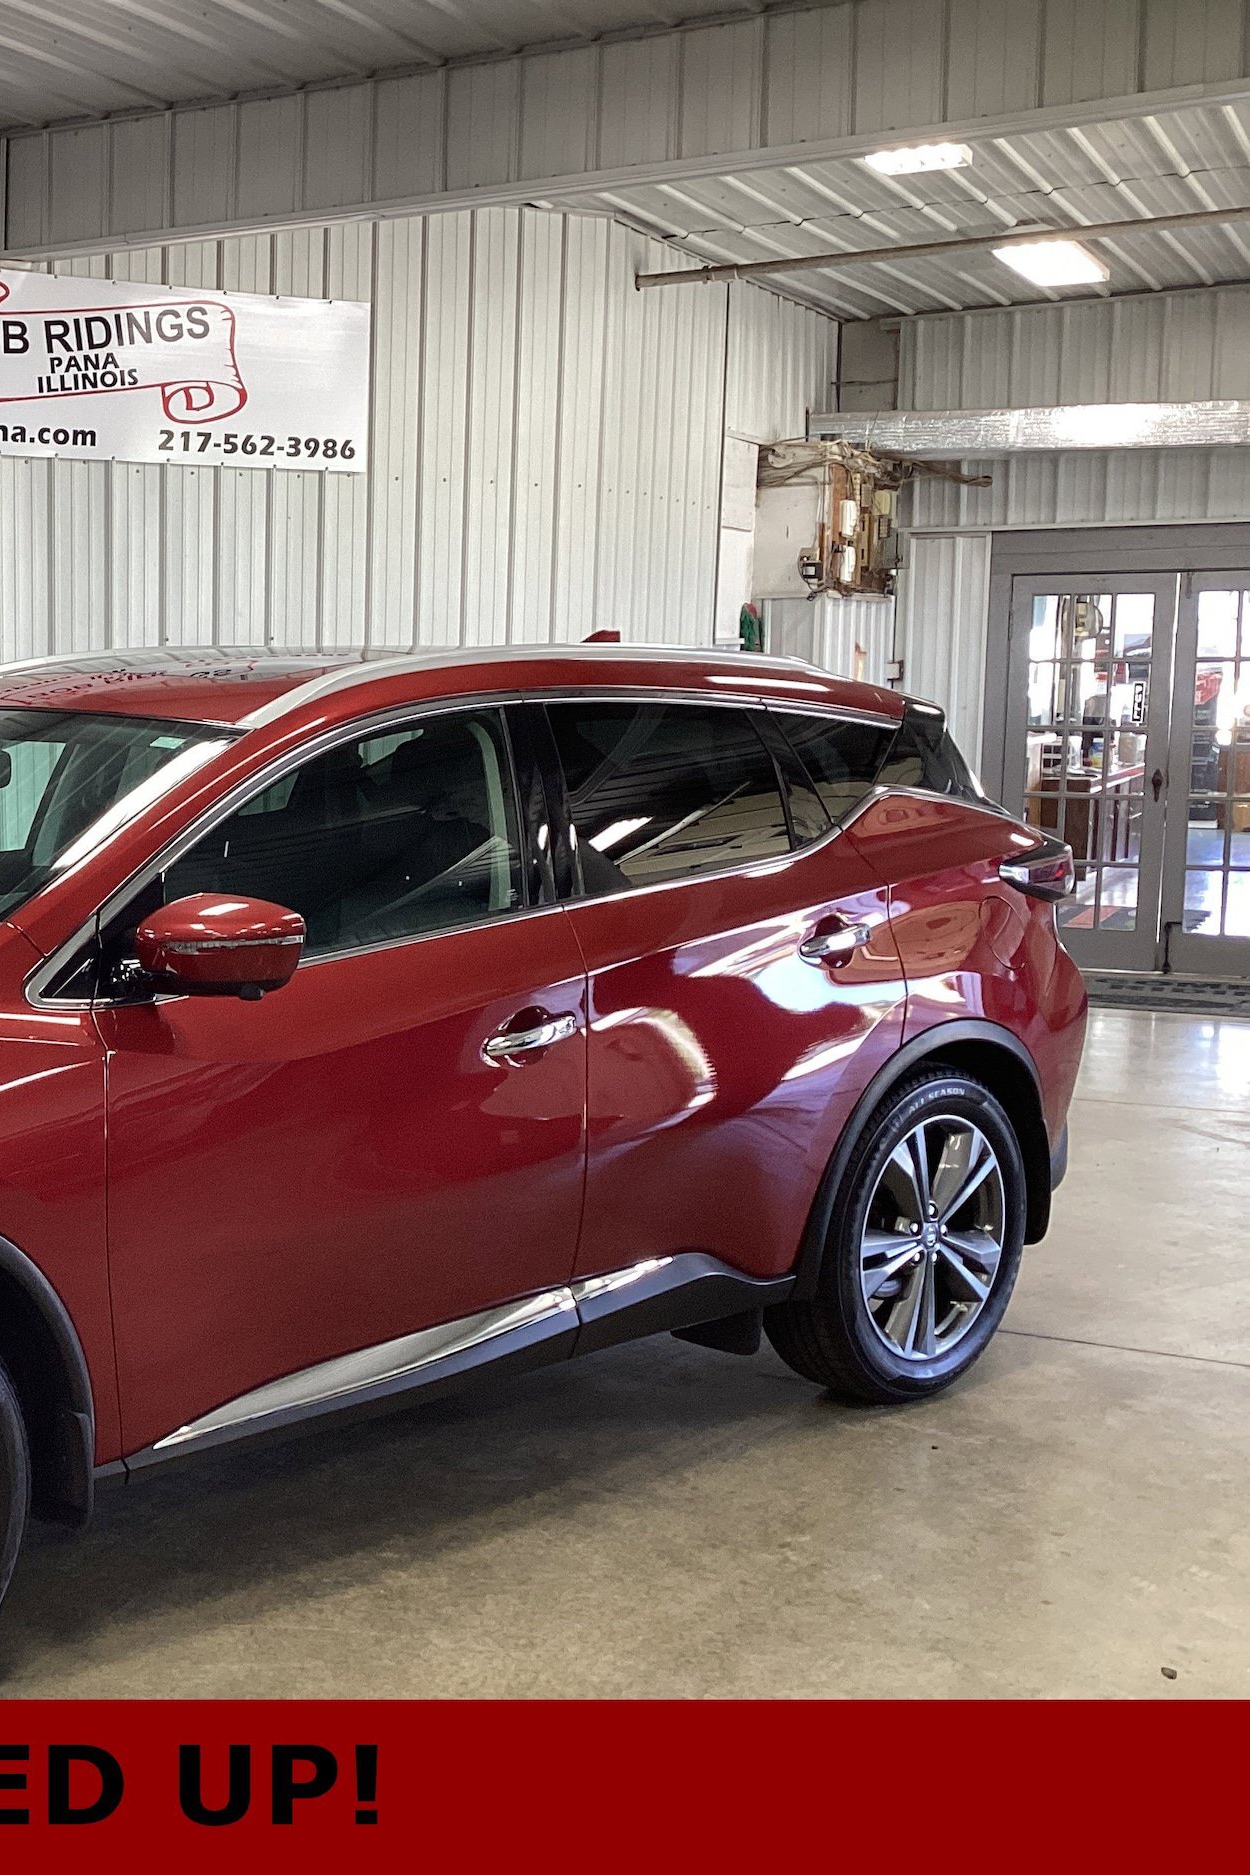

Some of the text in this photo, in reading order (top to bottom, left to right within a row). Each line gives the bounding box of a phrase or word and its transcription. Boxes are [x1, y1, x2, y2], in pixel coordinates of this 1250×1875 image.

[43, 306, 211, 354] RIDINGS
[49, 352, 120, 375] PANA
[37, 368, 140, 394] ILLINOIS
[158, 429, 357, 460] 217-562-3986
